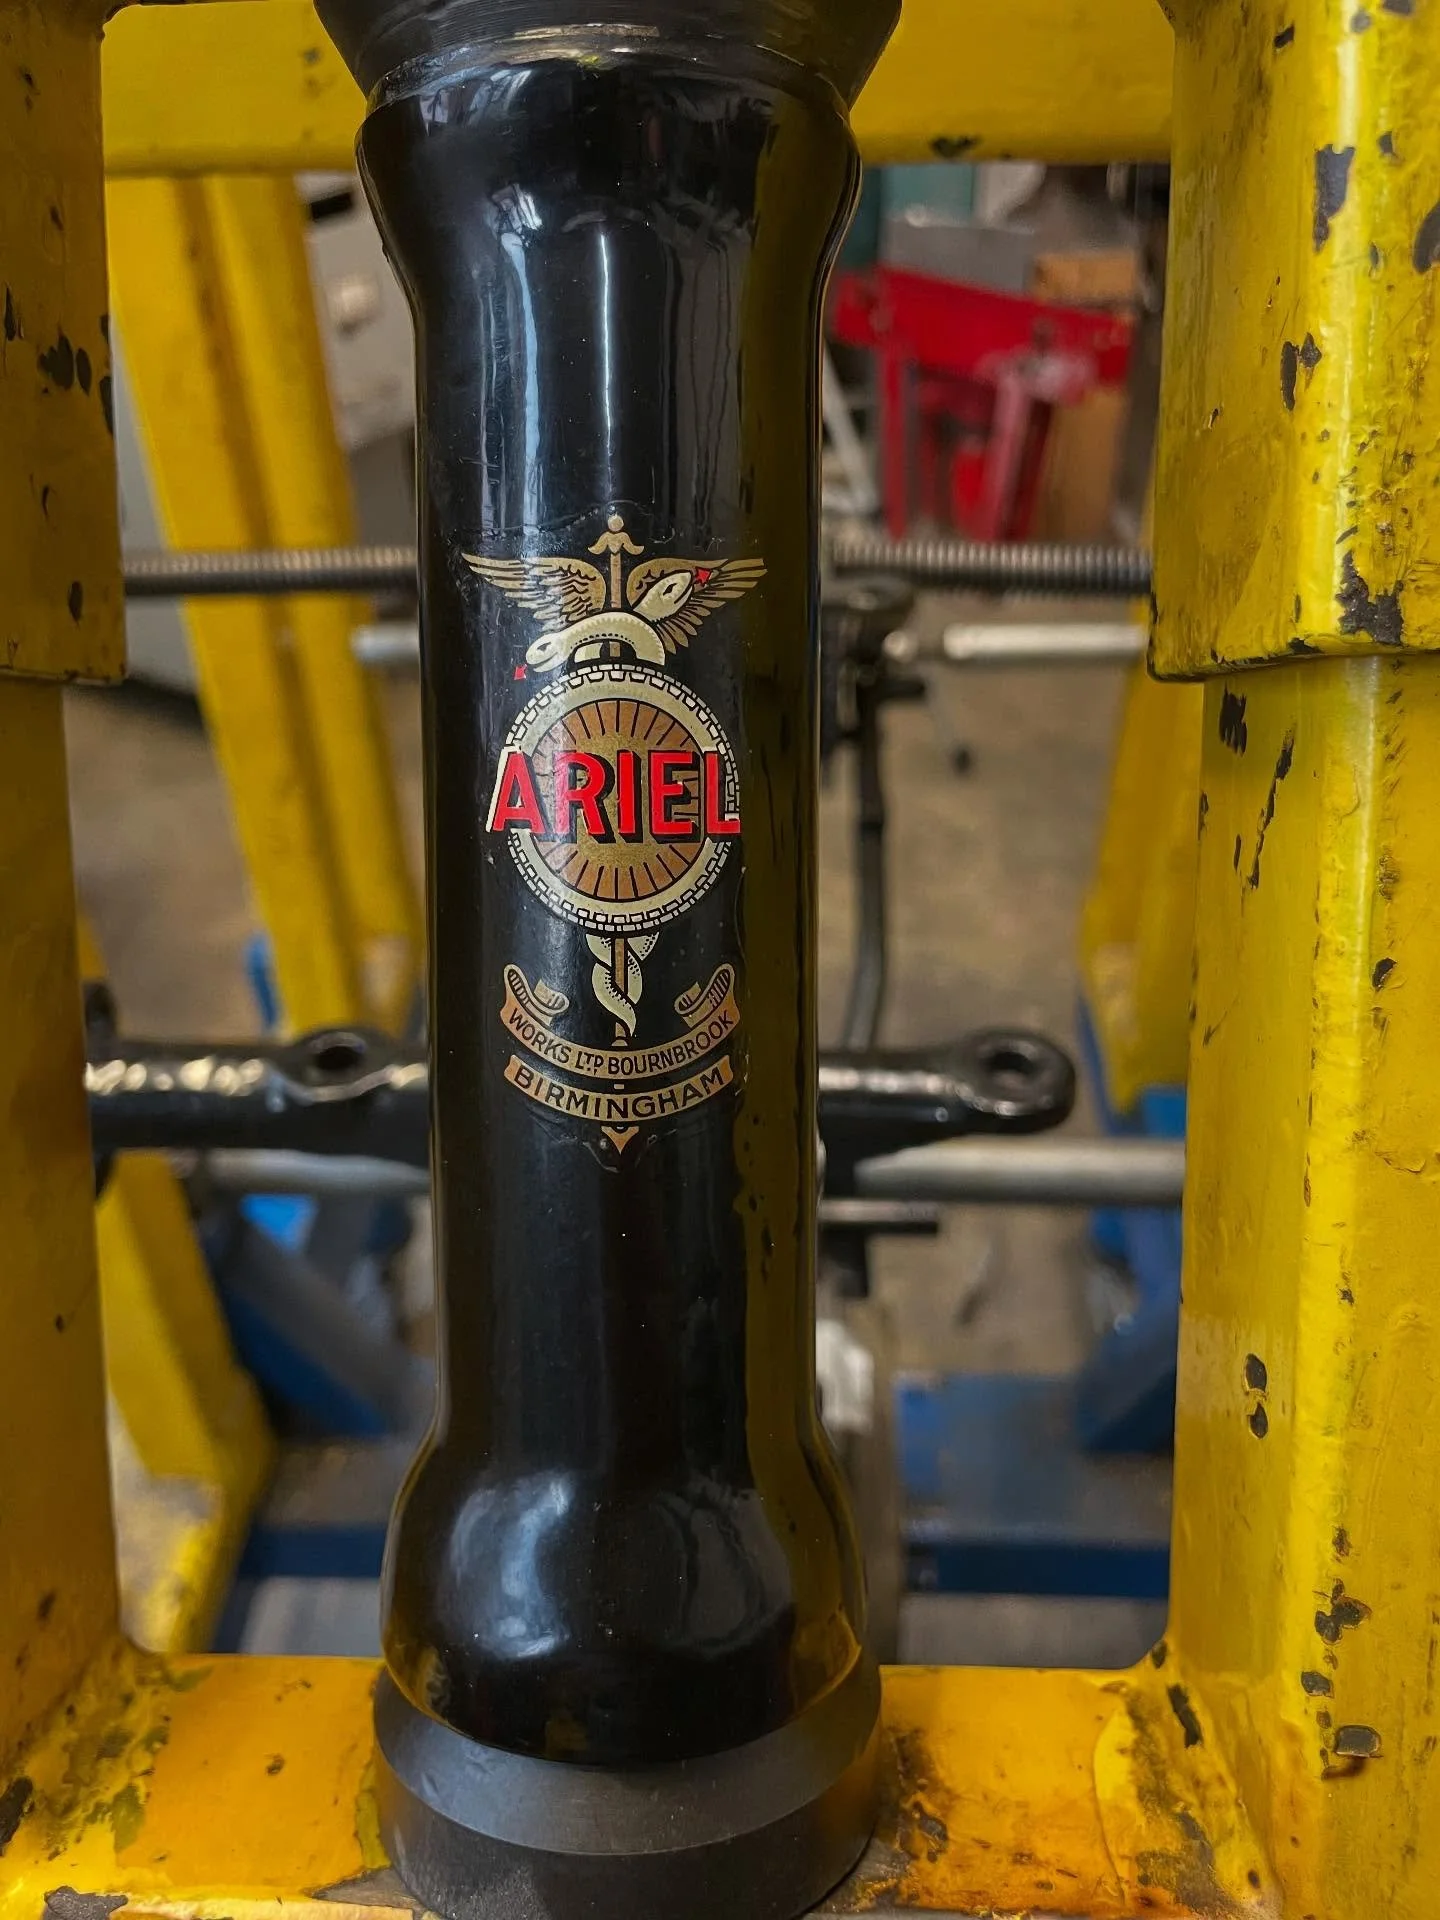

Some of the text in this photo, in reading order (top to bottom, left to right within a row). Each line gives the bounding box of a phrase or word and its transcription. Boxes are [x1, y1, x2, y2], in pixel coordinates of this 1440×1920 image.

[490, 750, 741, 838] ARIEL
[509, 1007, 572, 1064] WORKS
[608, 1010, 733, 1075] BOURNBROOK
[513, 1067, 724, 1120] BIRMINGHAM
